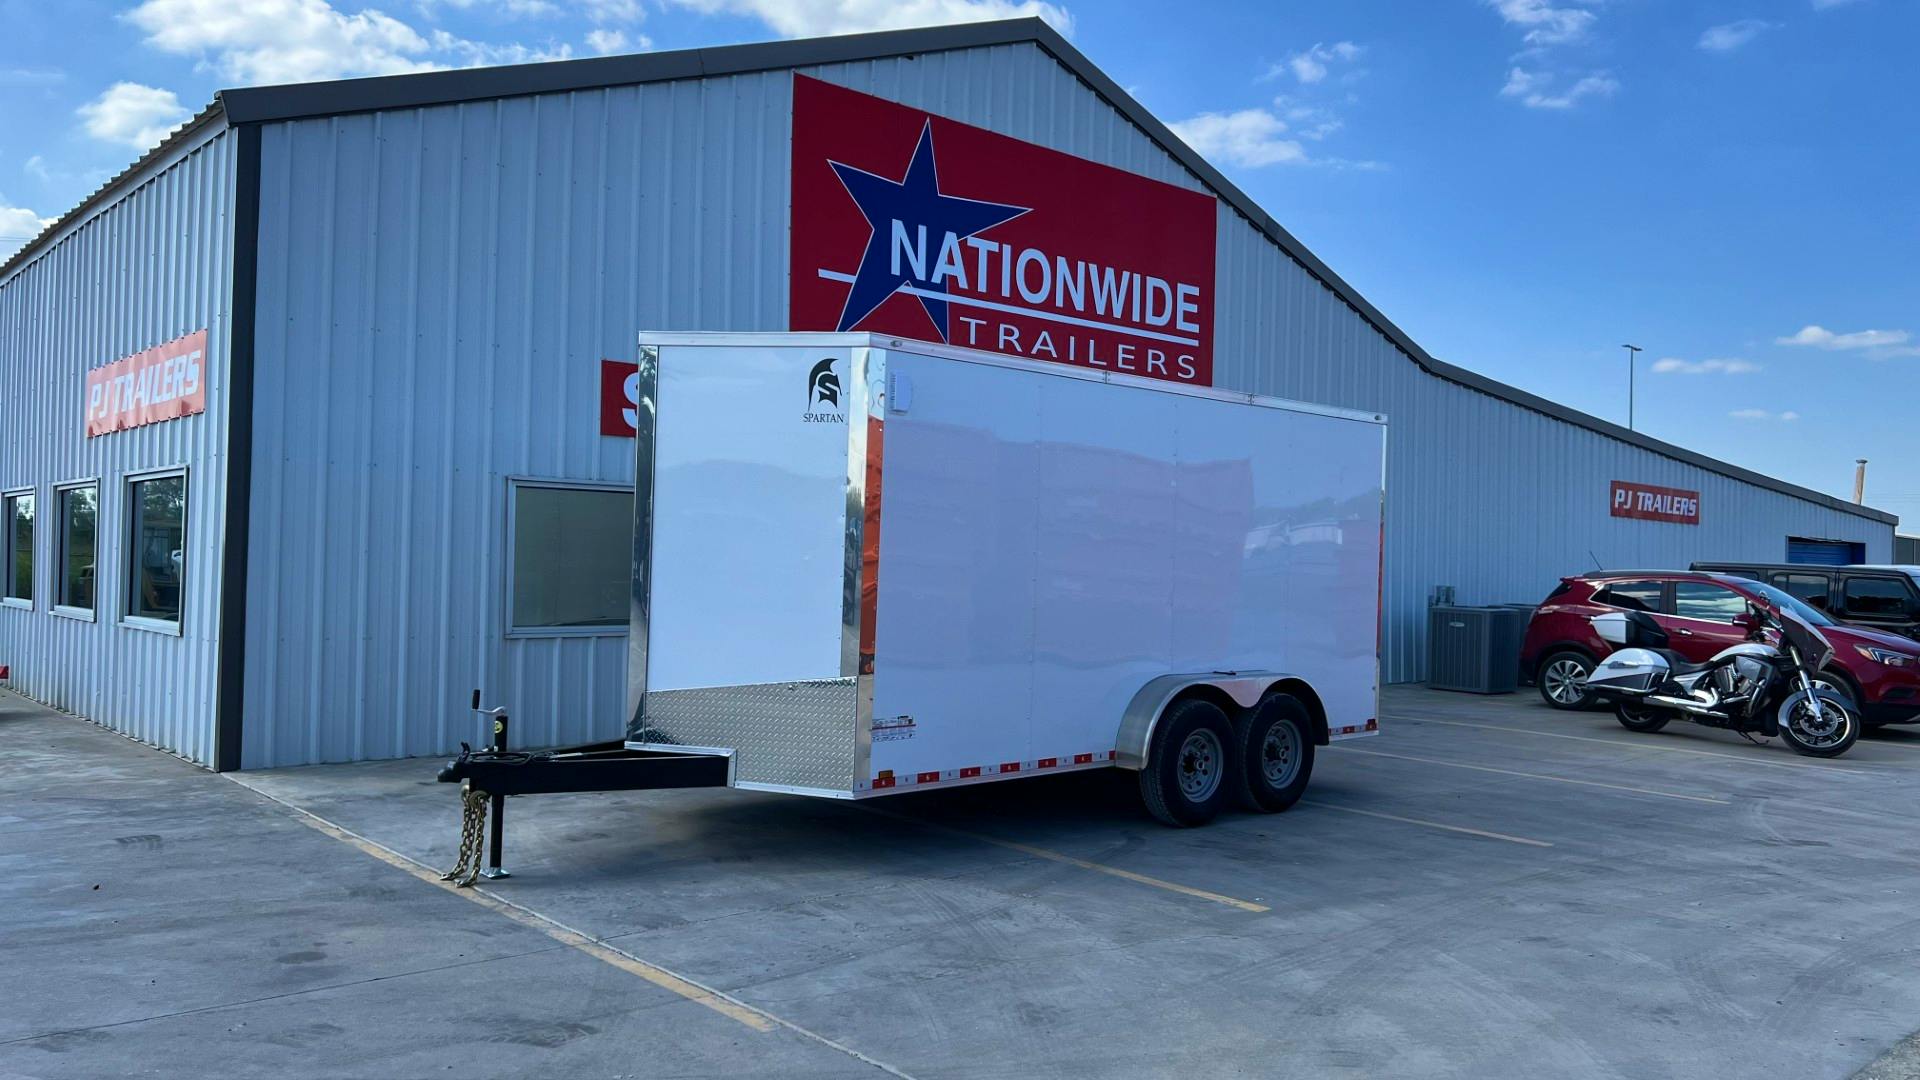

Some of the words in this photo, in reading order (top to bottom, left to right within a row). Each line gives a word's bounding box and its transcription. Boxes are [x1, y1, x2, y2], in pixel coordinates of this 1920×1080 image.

[890, 218, 1200, 334] NATIONWIDE
[959, 316, 1196, 380] TRAILERS
[89, 381, 111, 421] PJ
[113, 349, 201, 416] TRAILERS
[803, 413, 844, 423] SPARTAN
[1614, 488, 1633, 509] PJ
[1637, 491, 1697, 517] TRAILERS
